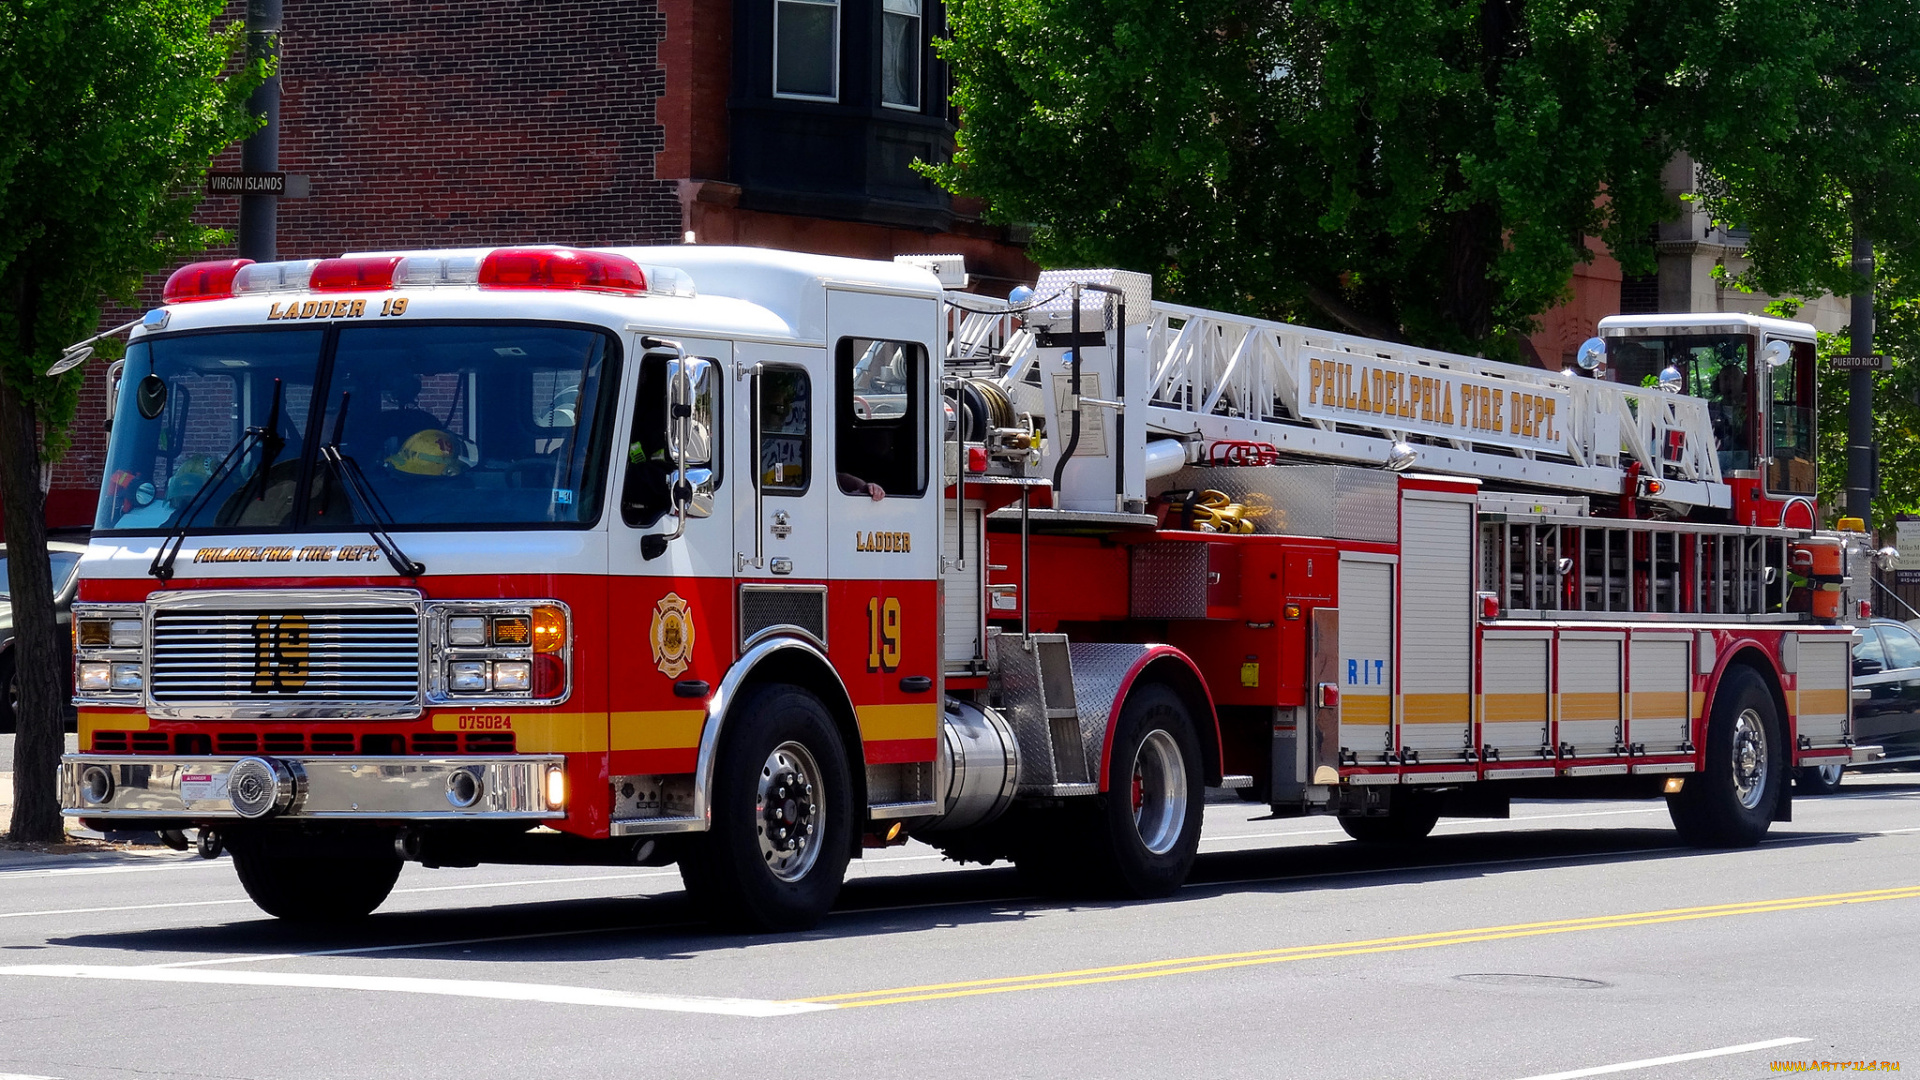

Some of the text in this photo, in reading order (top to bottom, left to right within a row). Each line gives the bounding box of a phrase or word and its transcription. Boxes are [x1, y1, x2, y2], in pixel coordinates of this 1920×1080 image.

[211, 176, 283, 190] VIRGIN ISLANDS
[267, 297, 409, 321] LADDER 19
[1832, 357, 1880, 366] PUERTO RICO
[1309, 358, 1560, 442] PHILADELPHIA FIRE DEPT.
[856, 531, 911, 553] LADDER
[193, 545, 380, 563] PHILADELPHIA FIRE DEPT.
[866, 597, 901, 673] 19
[251, 615, 309, 693] 19
[1348, 659, 1383, 685] RIT
[458, 715, 512, 729] 075024
[1384, 731, 1391, 747] 3
[1463, 729, 1470, 744] 5
[1541, 727, 1546, 742] 7
[1614, 725, 1620, 740] 9
